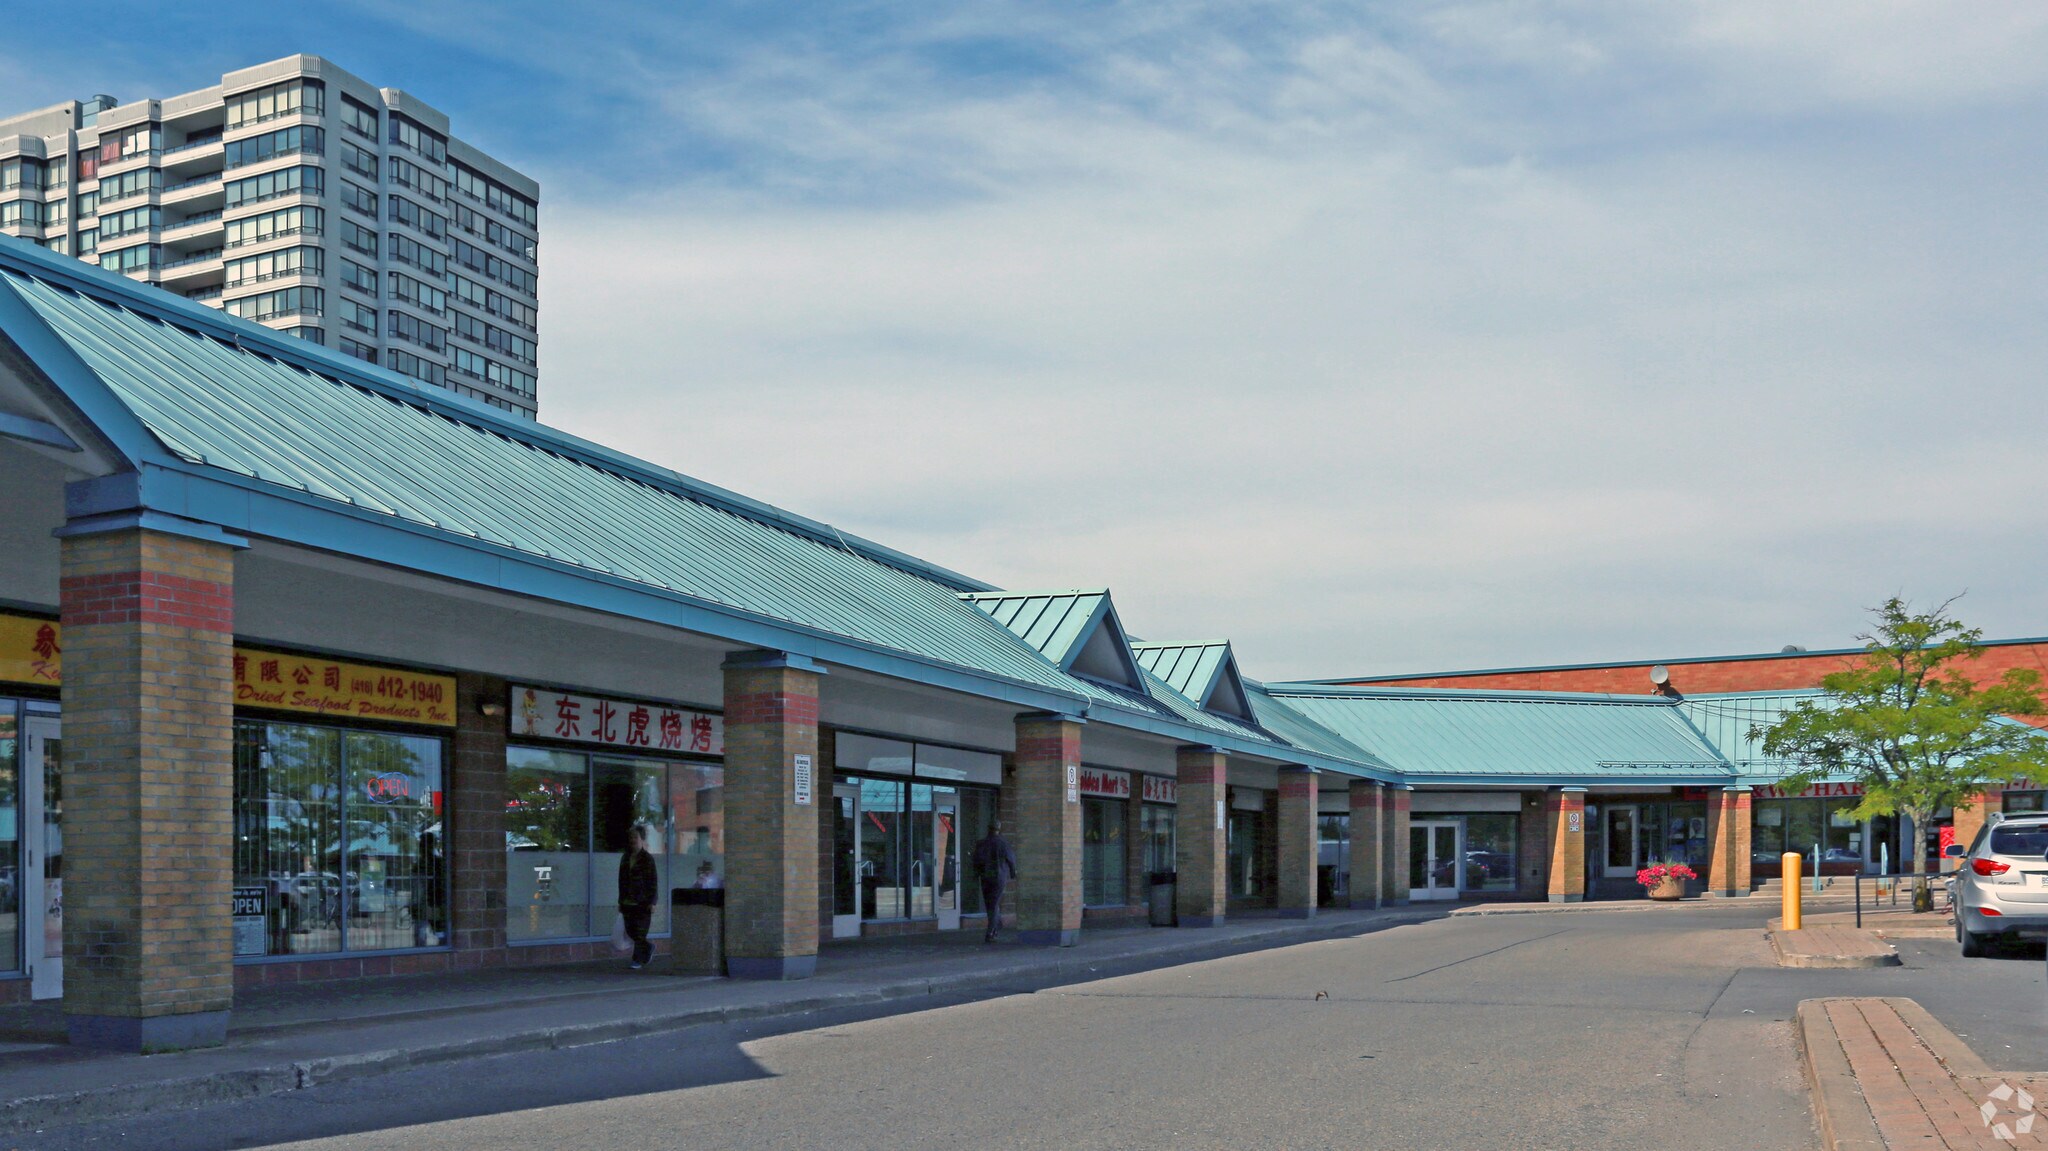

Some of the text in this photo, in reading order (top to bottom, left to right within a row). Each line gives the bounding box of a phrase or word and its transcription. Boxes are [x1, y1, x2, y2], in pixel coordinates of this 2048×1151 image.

[233, 652, 340, 692] 有限公司
[237, 684, 285, 704] Dried
[290, 690, 352, 713] Seafood
[358, 701, 420, 717] Products
[351, 675, 443, 703] (416) 412-1940
[554, 695, 724, 753] 东北虎烧烤
[367, 777, 409, 797] OPEN
[1081, 770, 1099, 792] olden
[1801, 782, 1867, 797] PHAR
